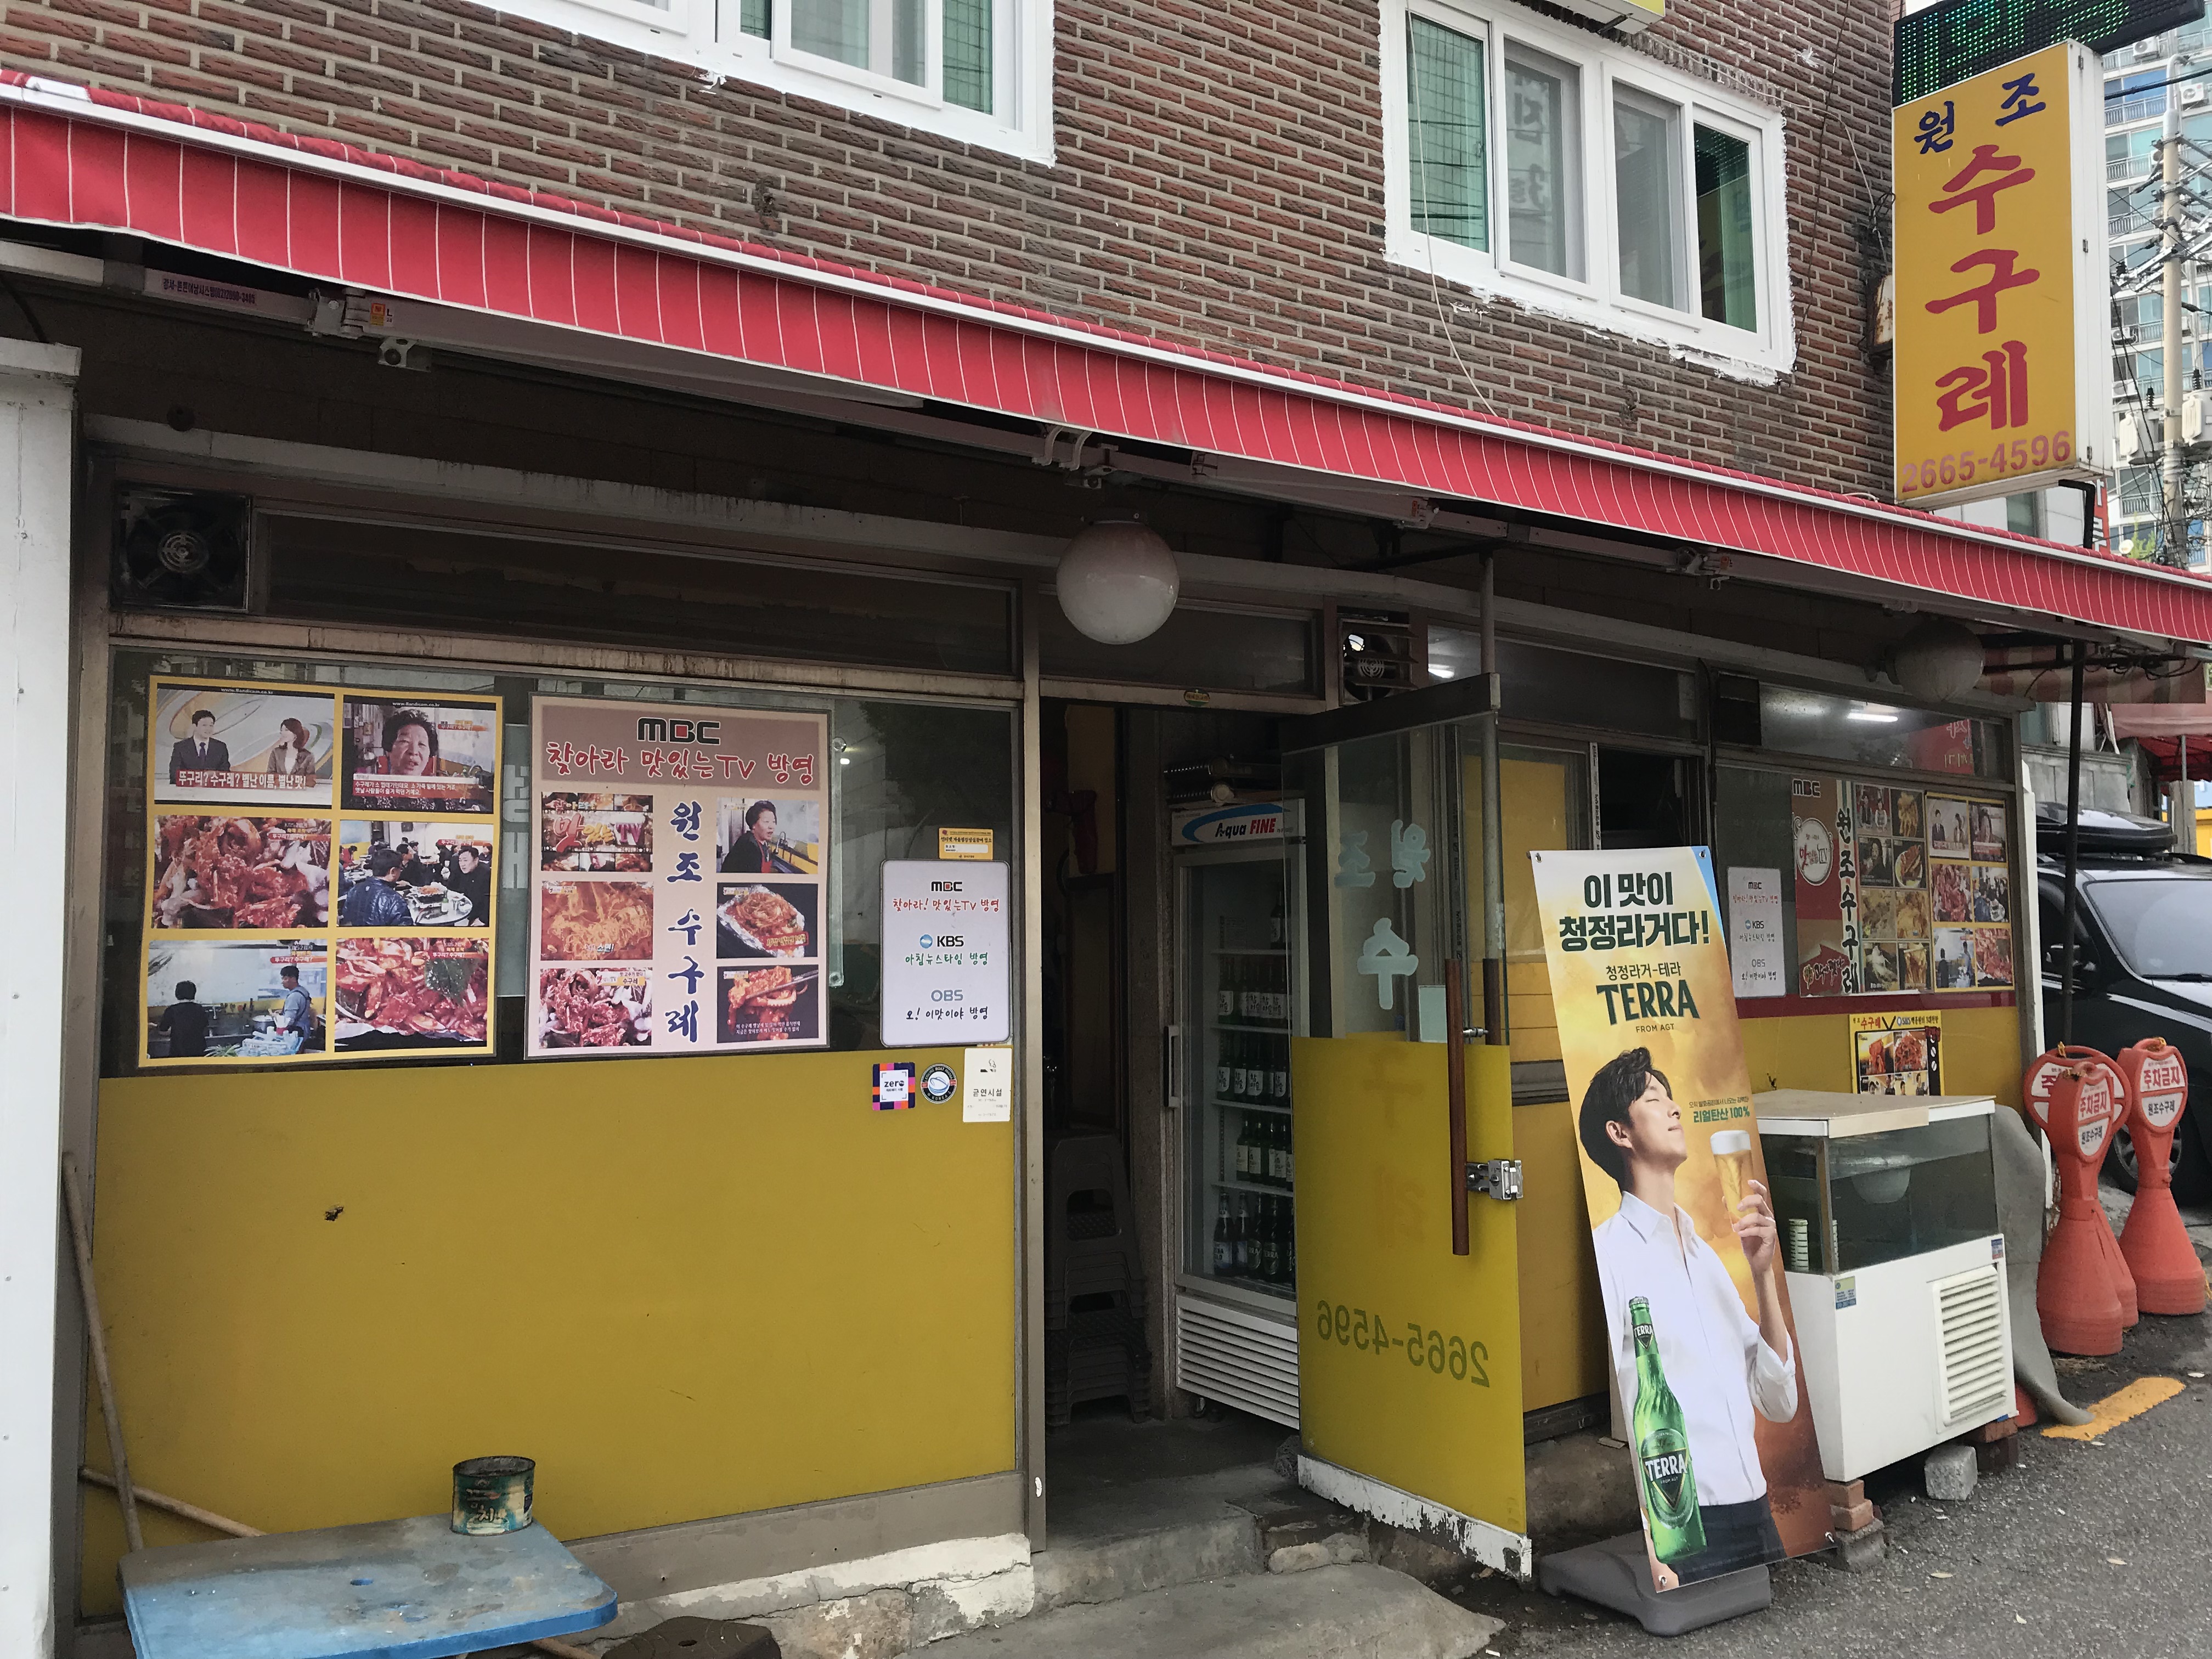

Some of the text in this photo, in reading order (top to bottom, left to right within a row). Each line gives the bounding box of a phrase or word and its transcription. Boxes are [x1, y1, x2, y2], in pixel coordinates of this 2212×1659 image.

[1914, 72, 2046, 155] 원조
[1925, 144, 2040, 432] 수구레
[1901, 430, 2072, 494] 2665-4596
[636, 716, 721, 745] MBC
[546, 741, 814, 785] 찾아라 맛있는TV 방영
[179, 771, 207, 785] 뚜구리?
[210, 772, 240, 787] 수구레?
[242, 774, 257, 788] 별난
[279, 774, 294, 789] 별난
[295, 775, 306, 790] 맛!
[1792, 778, 1820, 798] MBC
[1215, 818, 1277, 839] Aqua FINE
[666, 801, 703, 883] 원조
[931, 881, 963, 893] MBC
[1584, 872, 1673, 909] 이 맛이
[893, 898, 929, 911] 찾아라!
[980, 899, 1000, 912] 방영
[1559, 910, 1709, 952] 청정라거다!
[1752, 921, 1764, 929] KBS
[936, 935, 964, 948] KBS
[905, 952, 989, 966] 아침뉴스타임 방영
[1751, 959, 1765, 967] OBS
[664, 909, 704, 1043] 수구레
[1606, 962, 1681, 981] 청정라거-테라
[931, 989, 963, 1002] OBS
[1596, 979, 1700, 1025] TERRA
[906, 1007, 989, 1022] 오! 이맛이야 방영
[1635, 1025, 1657, 1033] FROM
[2143, 1066, 2181, 1089] 주차금지
[973, 1088, 1002, 1097] 금연시설
[2080, 1090, 2107, 1117] 주차금지
[1693, 1106, 1750, 1122] 리얼탄산 100%
[1633, 1325, 1654, 1337] TERRA
[1645, 1454, 1688, 1482] TERRA
